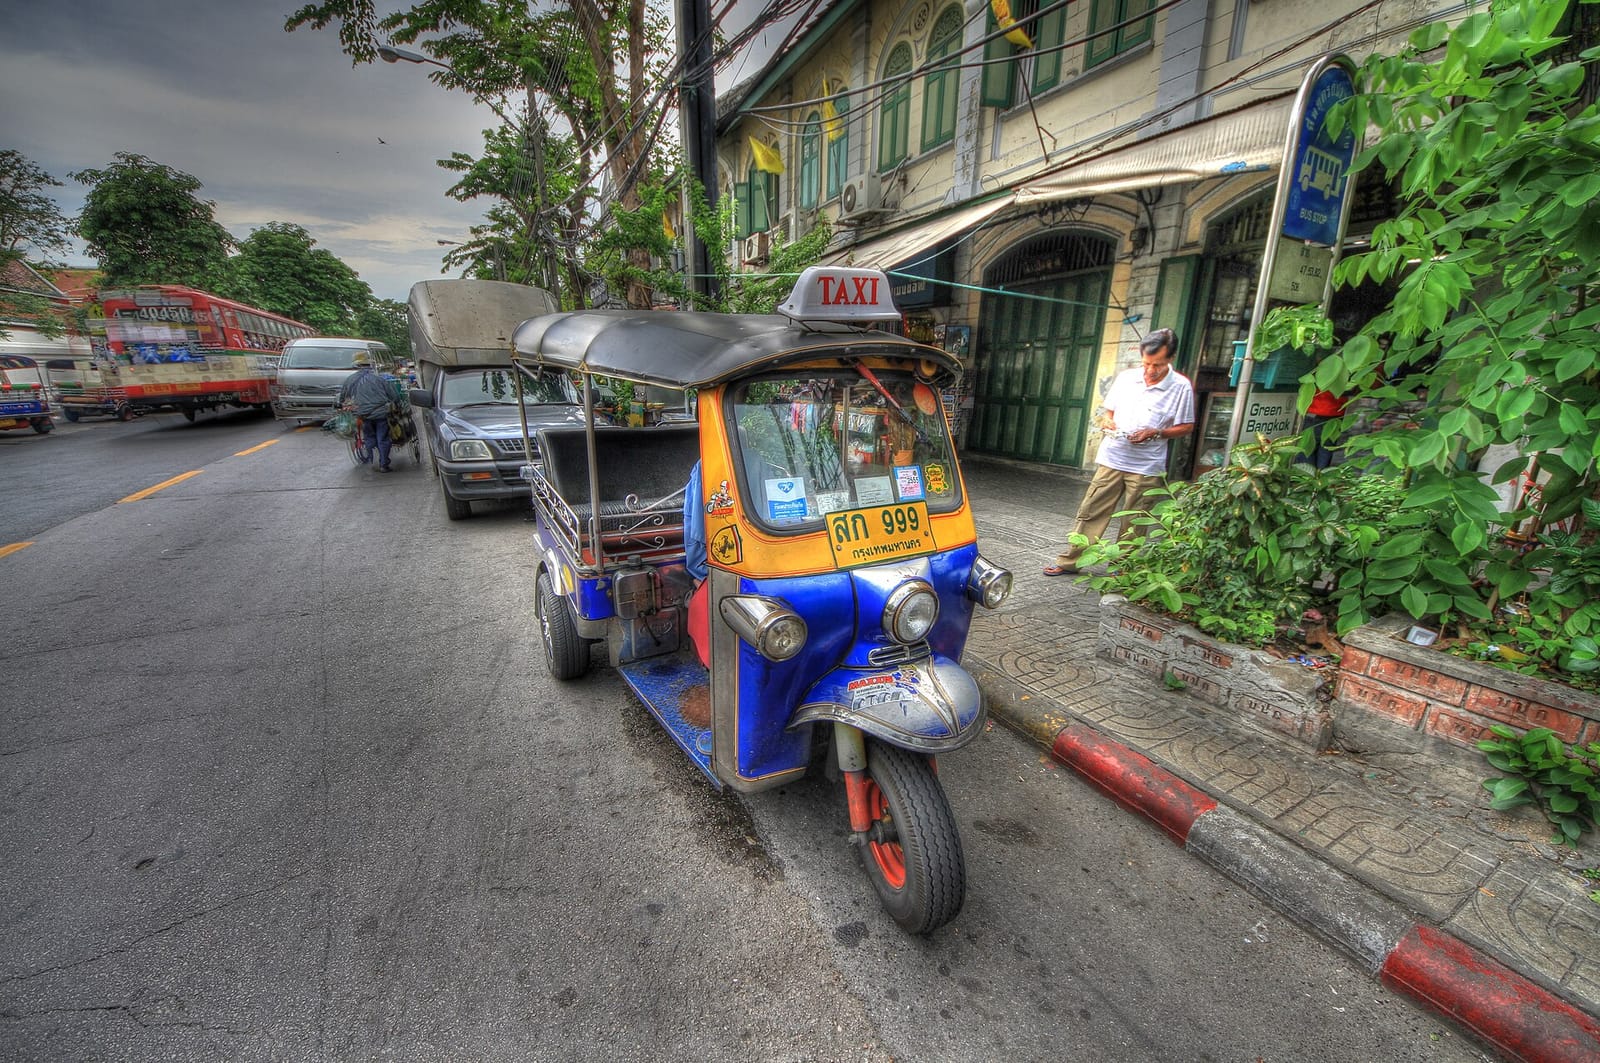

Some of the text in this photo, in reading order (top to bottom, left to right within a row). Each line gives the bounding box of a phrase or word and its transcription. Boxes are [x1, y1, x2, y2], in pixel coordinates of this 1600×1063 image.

[1300, 207, 1328, 225] BUS STOP
[817, 276, 880, 305] TAXI
[1250, 403, 1282, 417] Green
[1246, 419, 1290, 434] Bangkok
[881, 506, 919, 535] 999
[852, 538, 921, 560] กรุงเทพมหานคร
